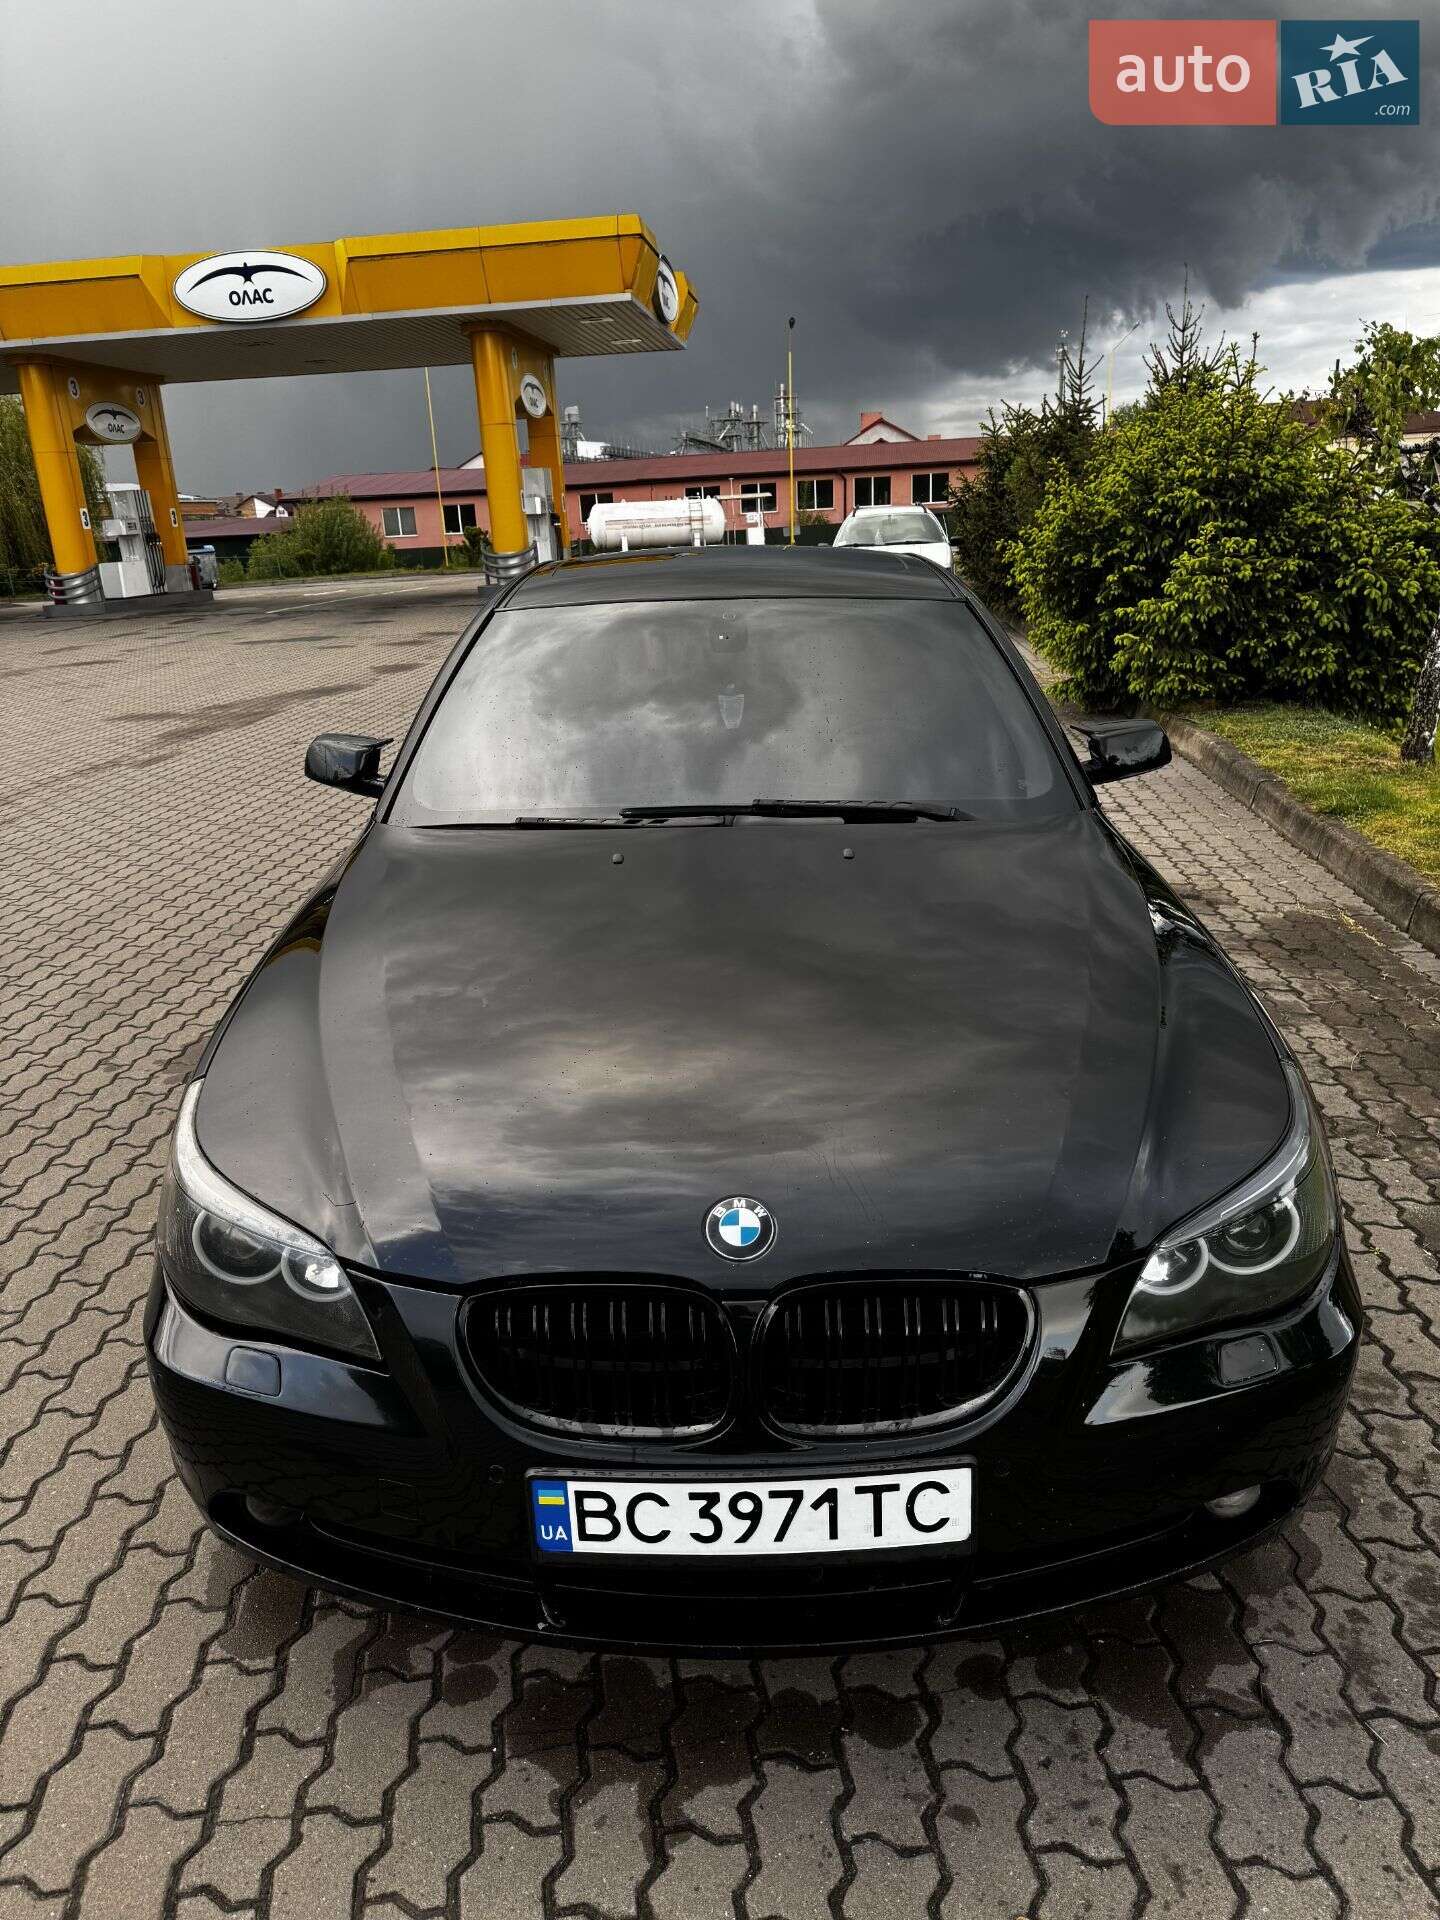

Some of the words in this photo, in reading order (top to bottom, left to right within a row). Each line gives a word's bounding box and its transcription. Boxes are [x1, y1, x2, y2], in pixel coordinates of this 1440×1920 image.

[228, 288, 274, 306] ОЛАС
[70, 380, 78, 397] 3
[82, 510, 89, 527] 3
[712, 1199, 768, 1218] BMW
[574, 1490, 672, 1544] BC
[688, 1487, 838, 1543] 3971
[855, 1480, 950, 1537] TC
[541, 1525, 568, 1541] UA
